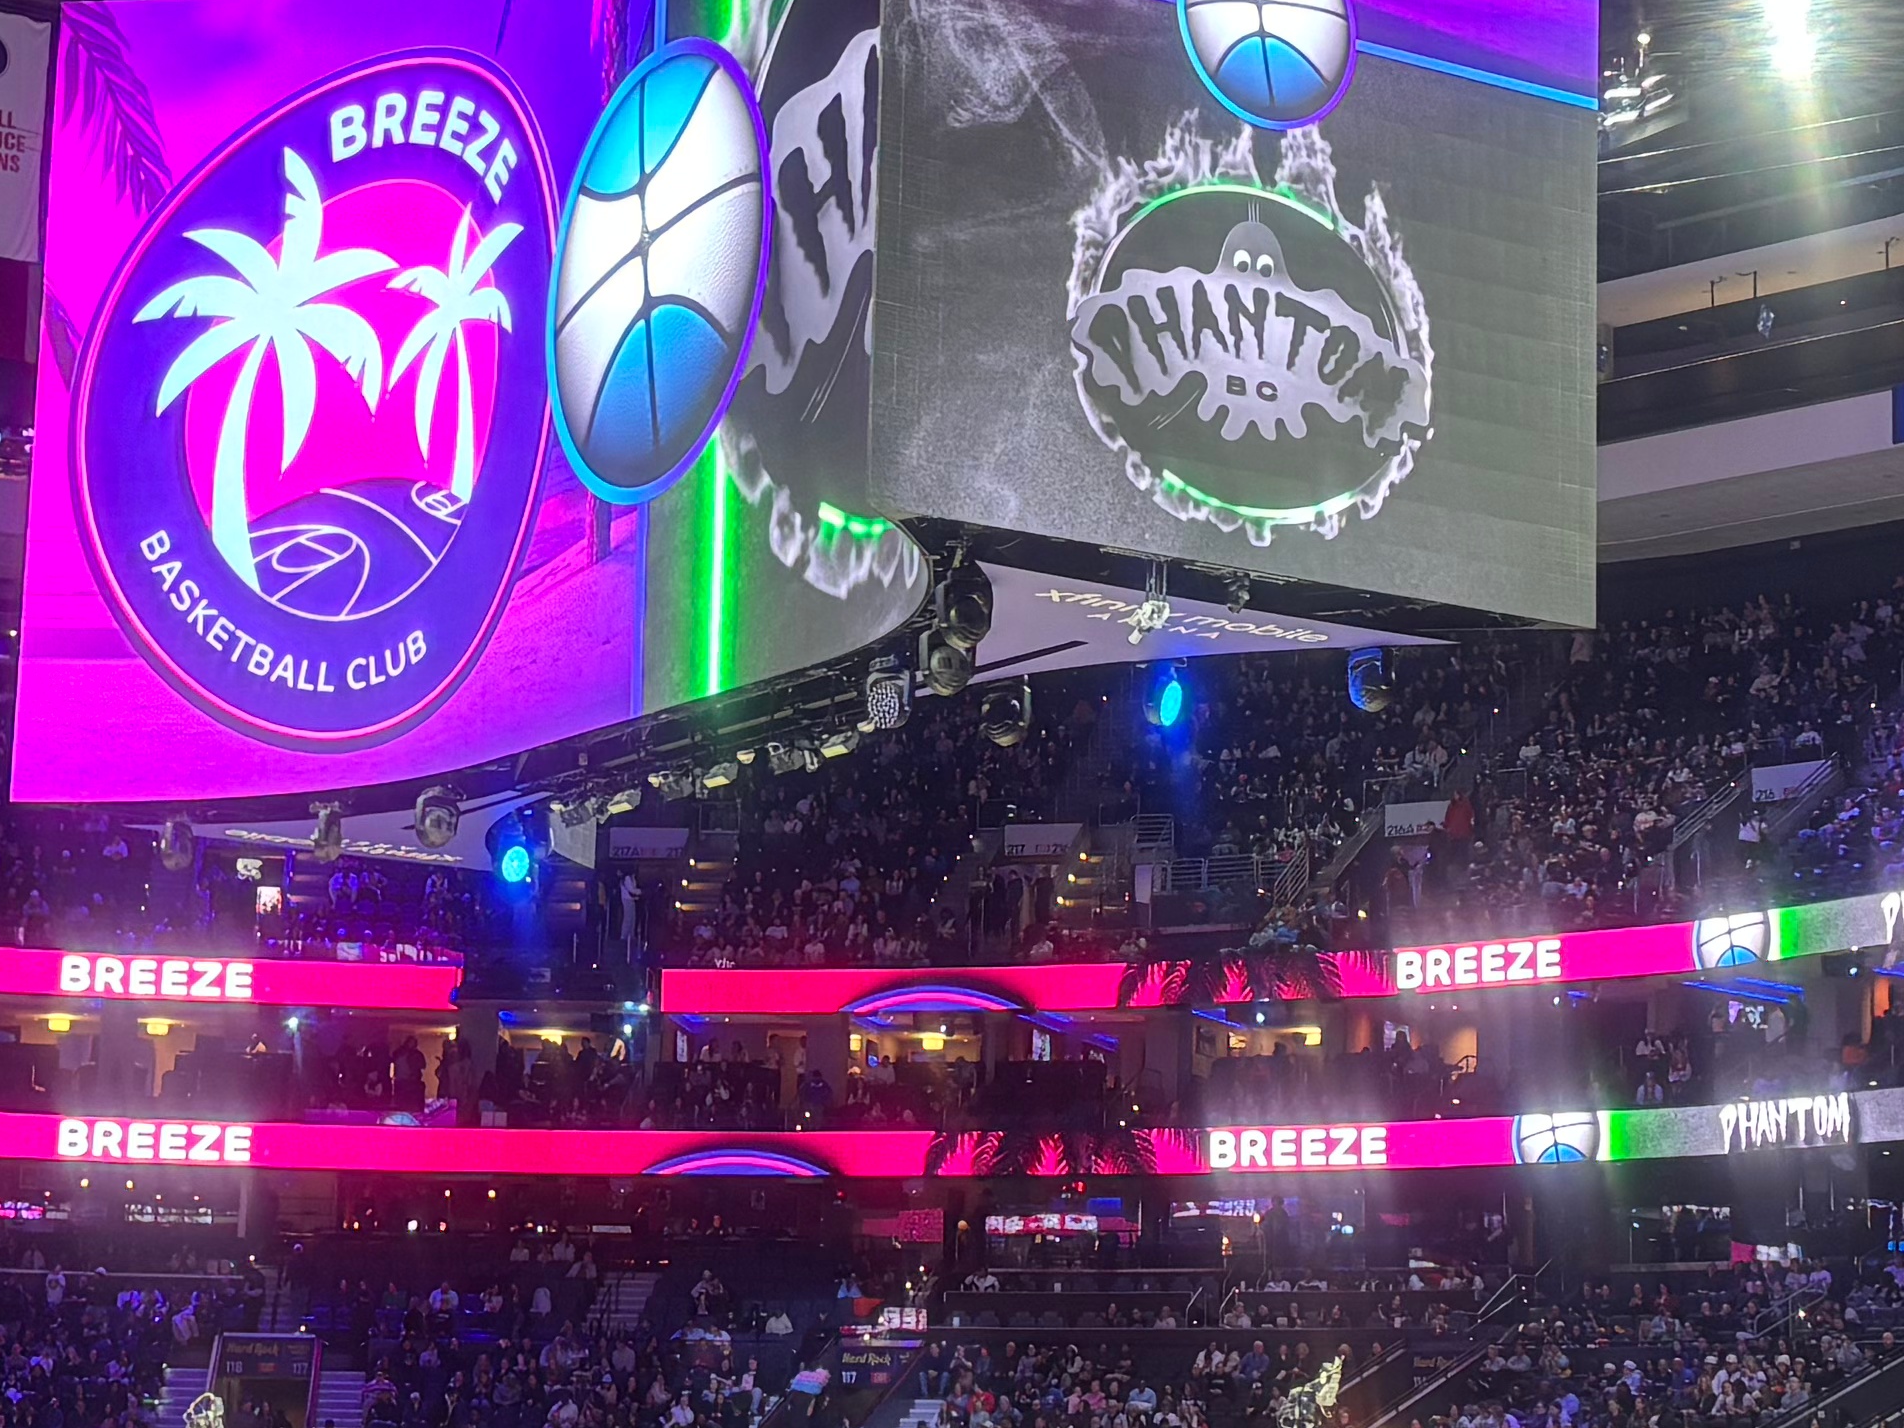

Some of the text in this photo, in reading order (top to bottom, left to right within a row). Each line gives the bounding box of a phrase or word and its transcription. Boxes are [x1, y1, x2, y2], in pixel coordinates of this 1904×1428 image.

[330, 90, 518, 205] BREEZE
[1093, 278, 1414, 422] PHANTOM
[1225, 373, 1280, 403] BC
[138, 530, 429, 696] BASKETBALL CLUB
[1183, 615, 1329, 643] mobile
[59, 955, 254, 1000] BREEZE
[1395, 938, 1563, 991] BREEZE
[57, 1121, 252, 1164] BREEZE
[1207, 1126, 1389, 1169] BREEZE
[1719, 1094, 1850, 1155] PHANTOM
